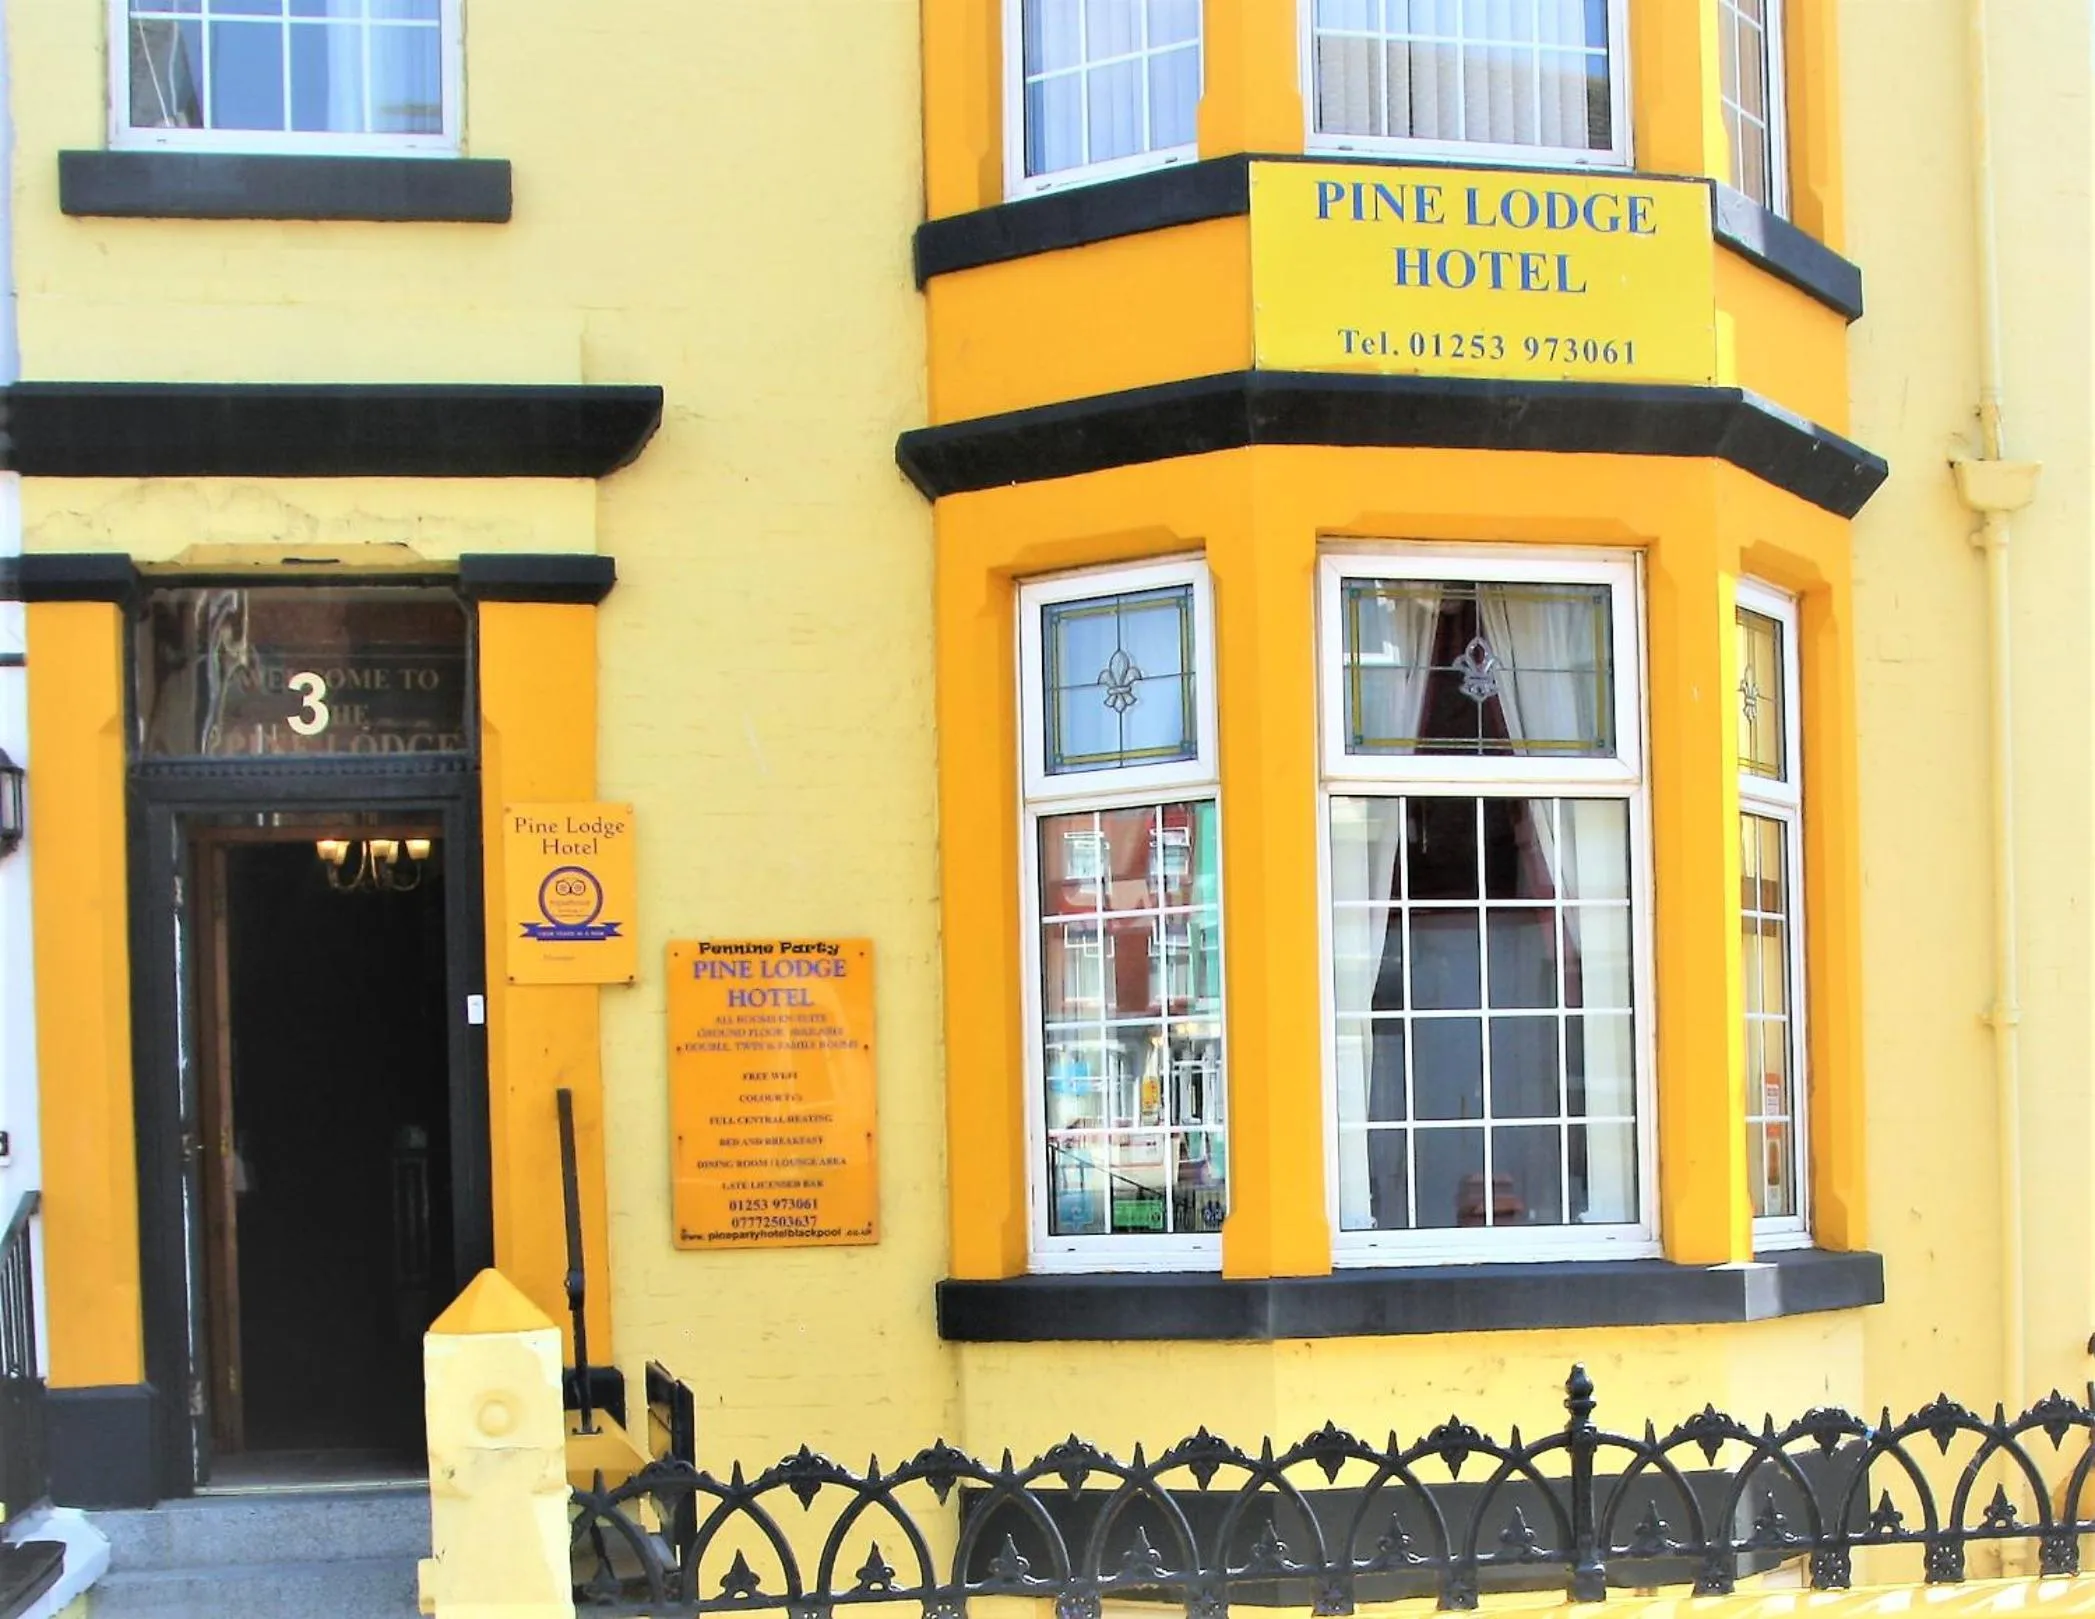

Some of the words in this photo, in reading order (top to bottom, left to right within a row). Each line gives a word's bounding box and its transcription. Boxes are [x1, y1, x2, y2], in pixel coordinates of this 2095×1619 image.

[1314, 180, 1446, 225] PINE
[1463, 186, 1658, 235] LODGE
[1391, 246, 1588, 294] HOTEL
[1337, 328, 1400, 357] Tel.
[1408, 331, 1506, 361] 01253
[1522, 335, 1637, 367] 973061
[398, 668, 440, 691] TO
[286, 671, 331, 736] 3
[514, 816, 559, 835] Pine
[566, 816, 626, 839] Lodge
[542, 838, 599, 855] Hotel
[780, 941, 840, 957] Party
[693, 959, 754, 980] PINE
[760, 958, 847, 979] LODGE
[728, 987, 815, 1008] HOTEL
[729, 1199, 768, 1212] 01253
[773, 1197, 818, 1211] 973061
